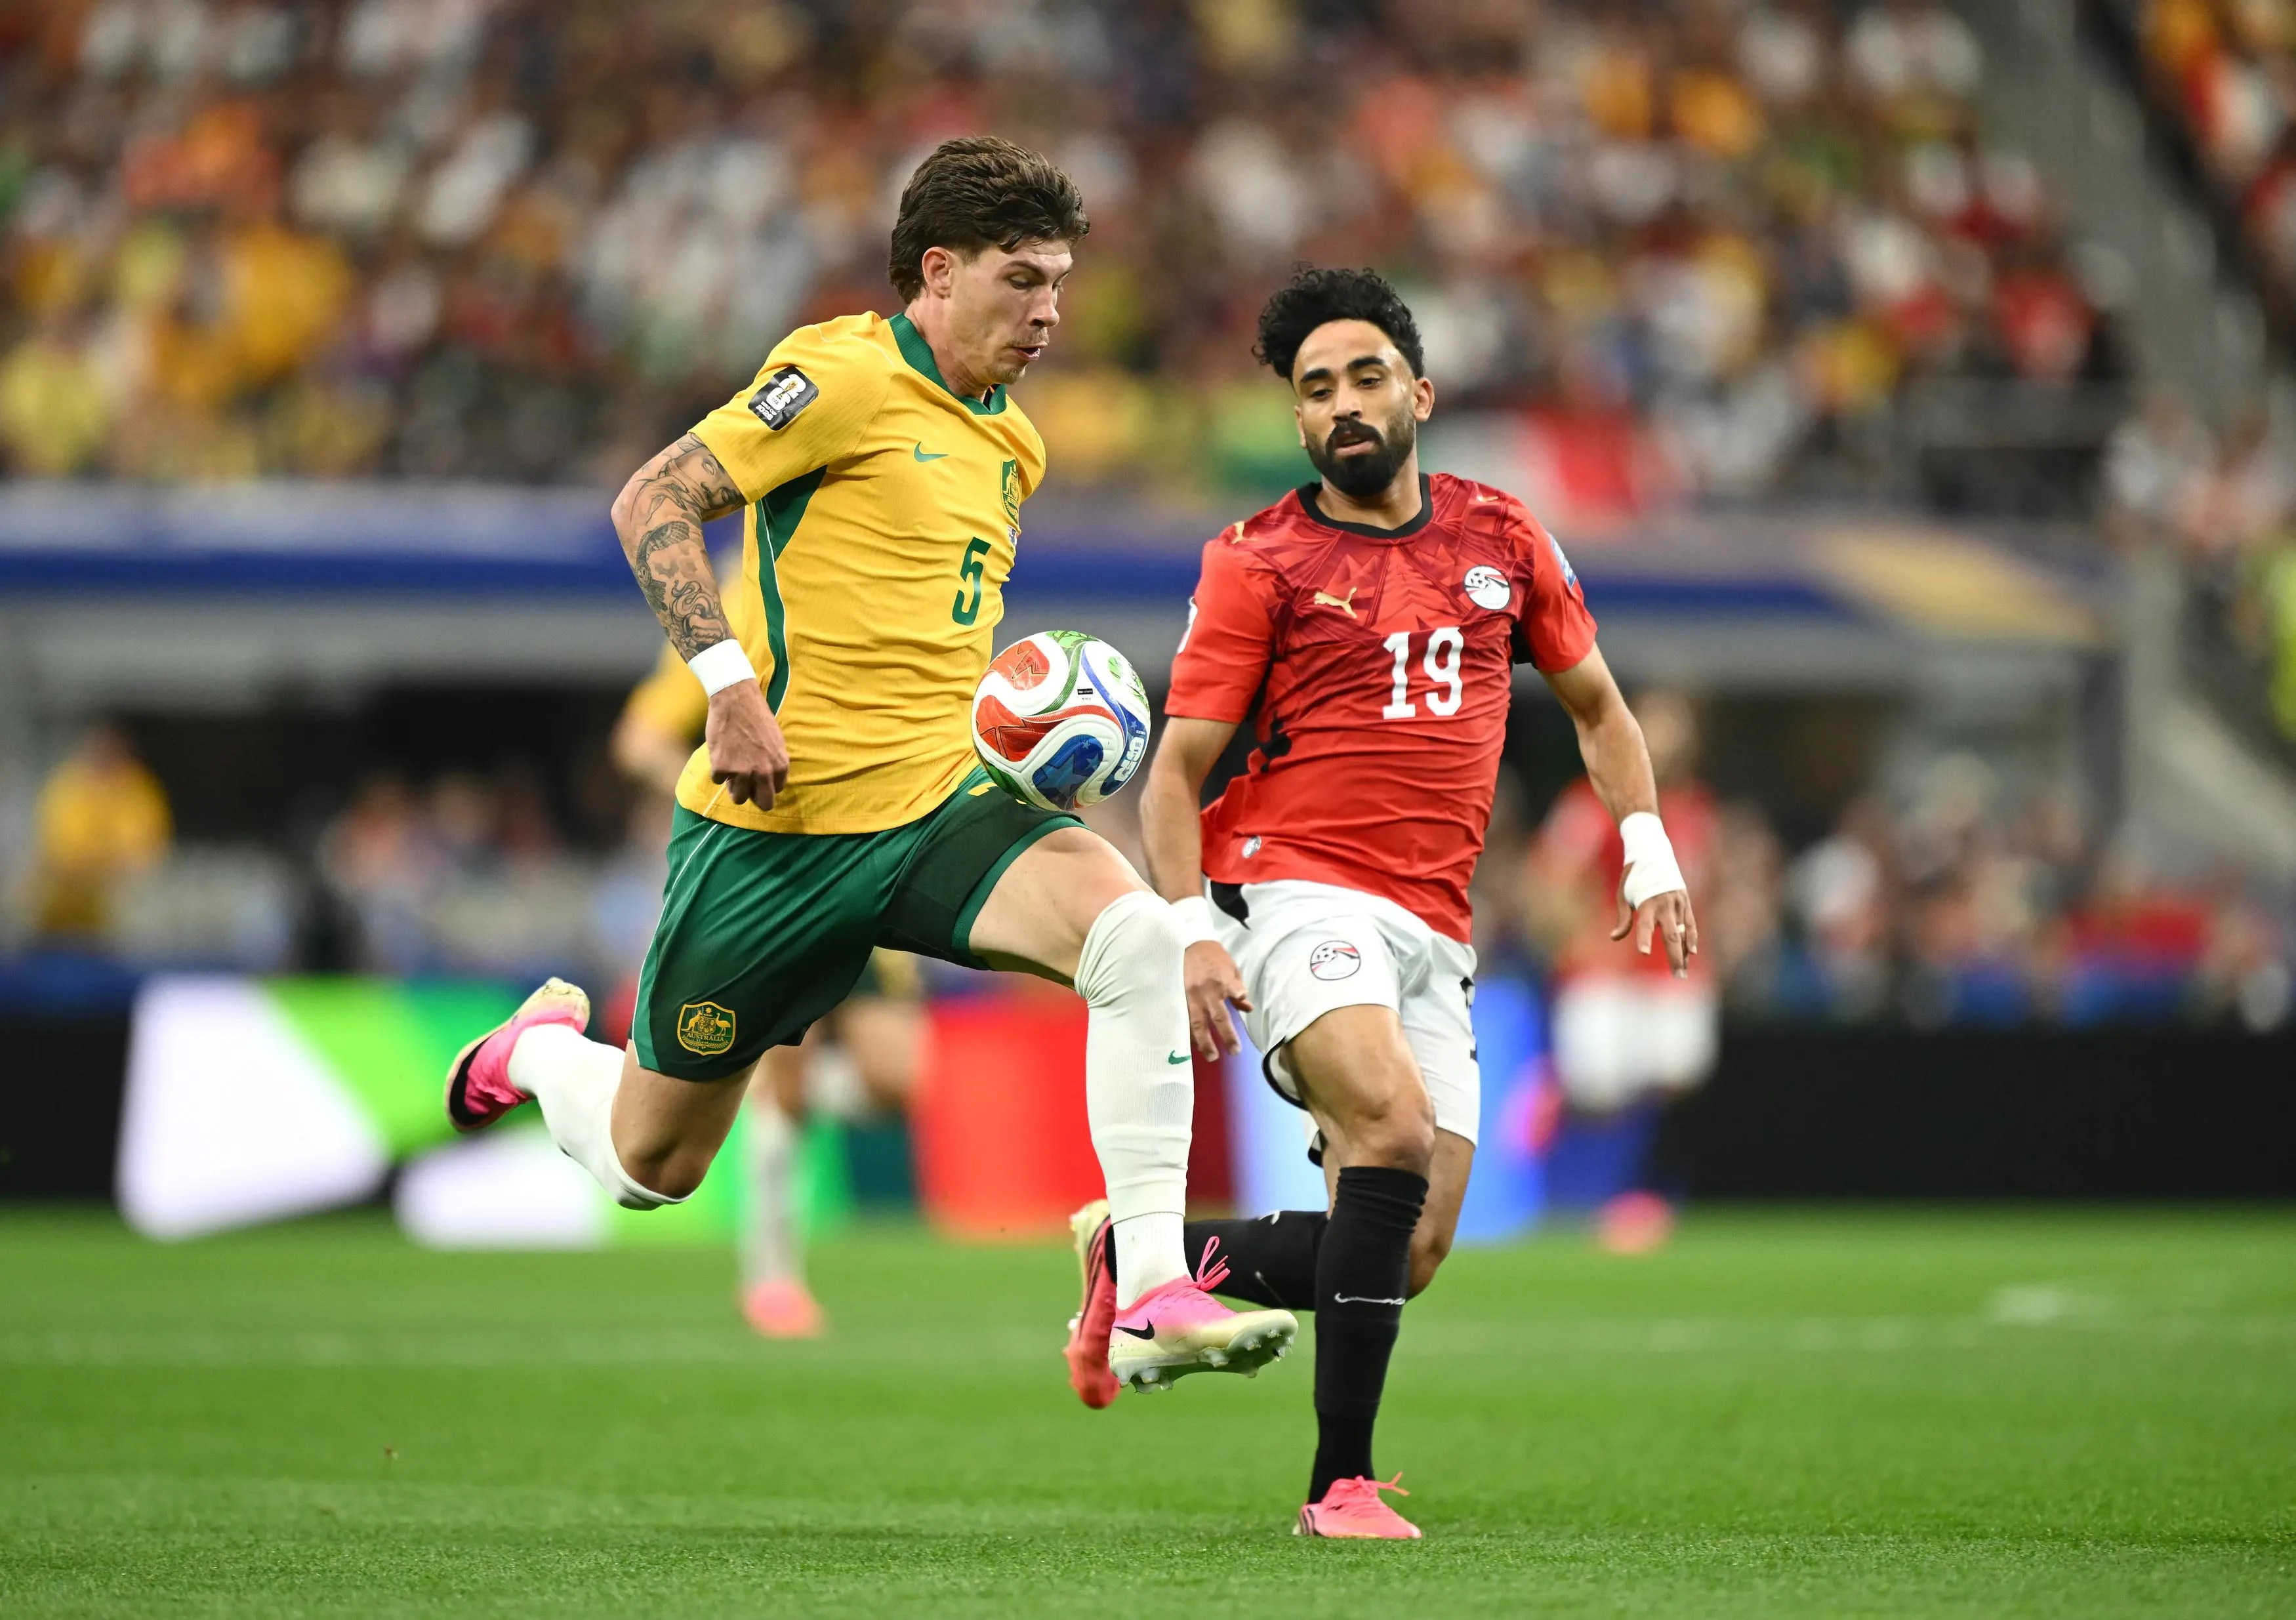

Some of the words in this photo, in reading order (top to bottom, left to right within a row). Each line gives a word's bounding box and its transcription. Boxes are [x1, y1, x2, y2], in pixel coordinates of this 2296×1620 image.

[755, 404, 773, 420] 2026
[952, 537, 991, 626] 5
[1382, 626, 1464, 720] 19
[687, 1032, 724, 1042] AUSTRALIA
